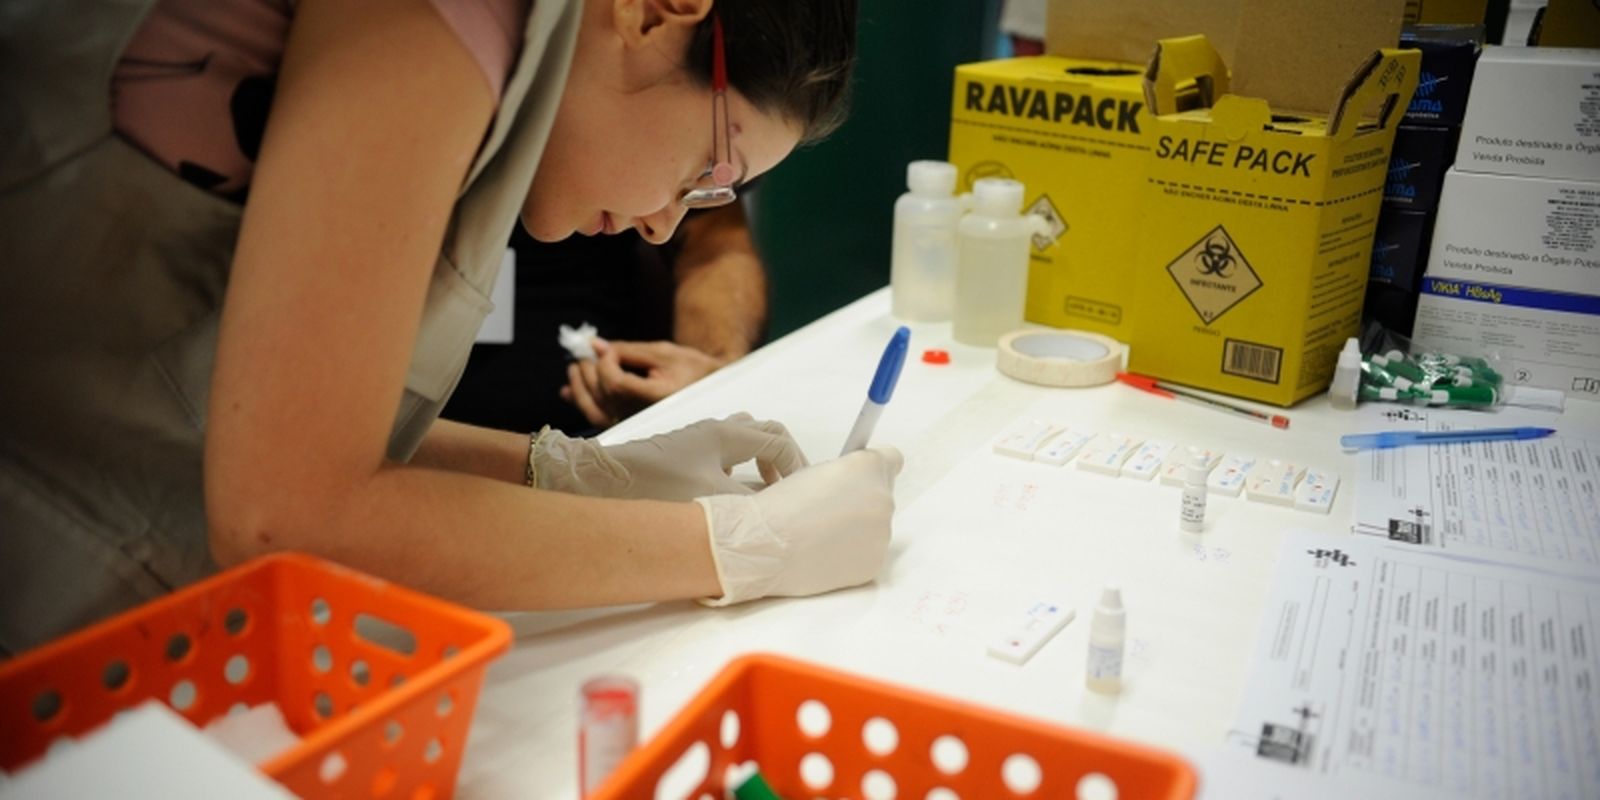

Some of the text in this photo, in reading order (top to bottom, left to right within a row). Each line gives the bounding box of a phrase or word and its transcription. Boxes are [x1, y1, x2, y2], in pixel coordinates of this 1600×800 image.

[965, 81, 1144, 134] RAVAPACK
[1475, 135, 1513, 147] Produto
[1515, 139, 1563, 151] destinado
[1575, 141, 1600, 155] Órgã
[1156, 135, 1228, 166] SAFE
[1232, 145, 1317, 178] PACK
[1473, 152, 1545, 165] Venda Proibida
[1445, 244, 1482, 257] Produto
[1484, 249, 1530, 262] destinado
[1541, 252, 1571, 267] Órgão
[1444, 260, 1513, 275] Venda Proibida
[1190, 278, 1237, 293] INFECTANTE
